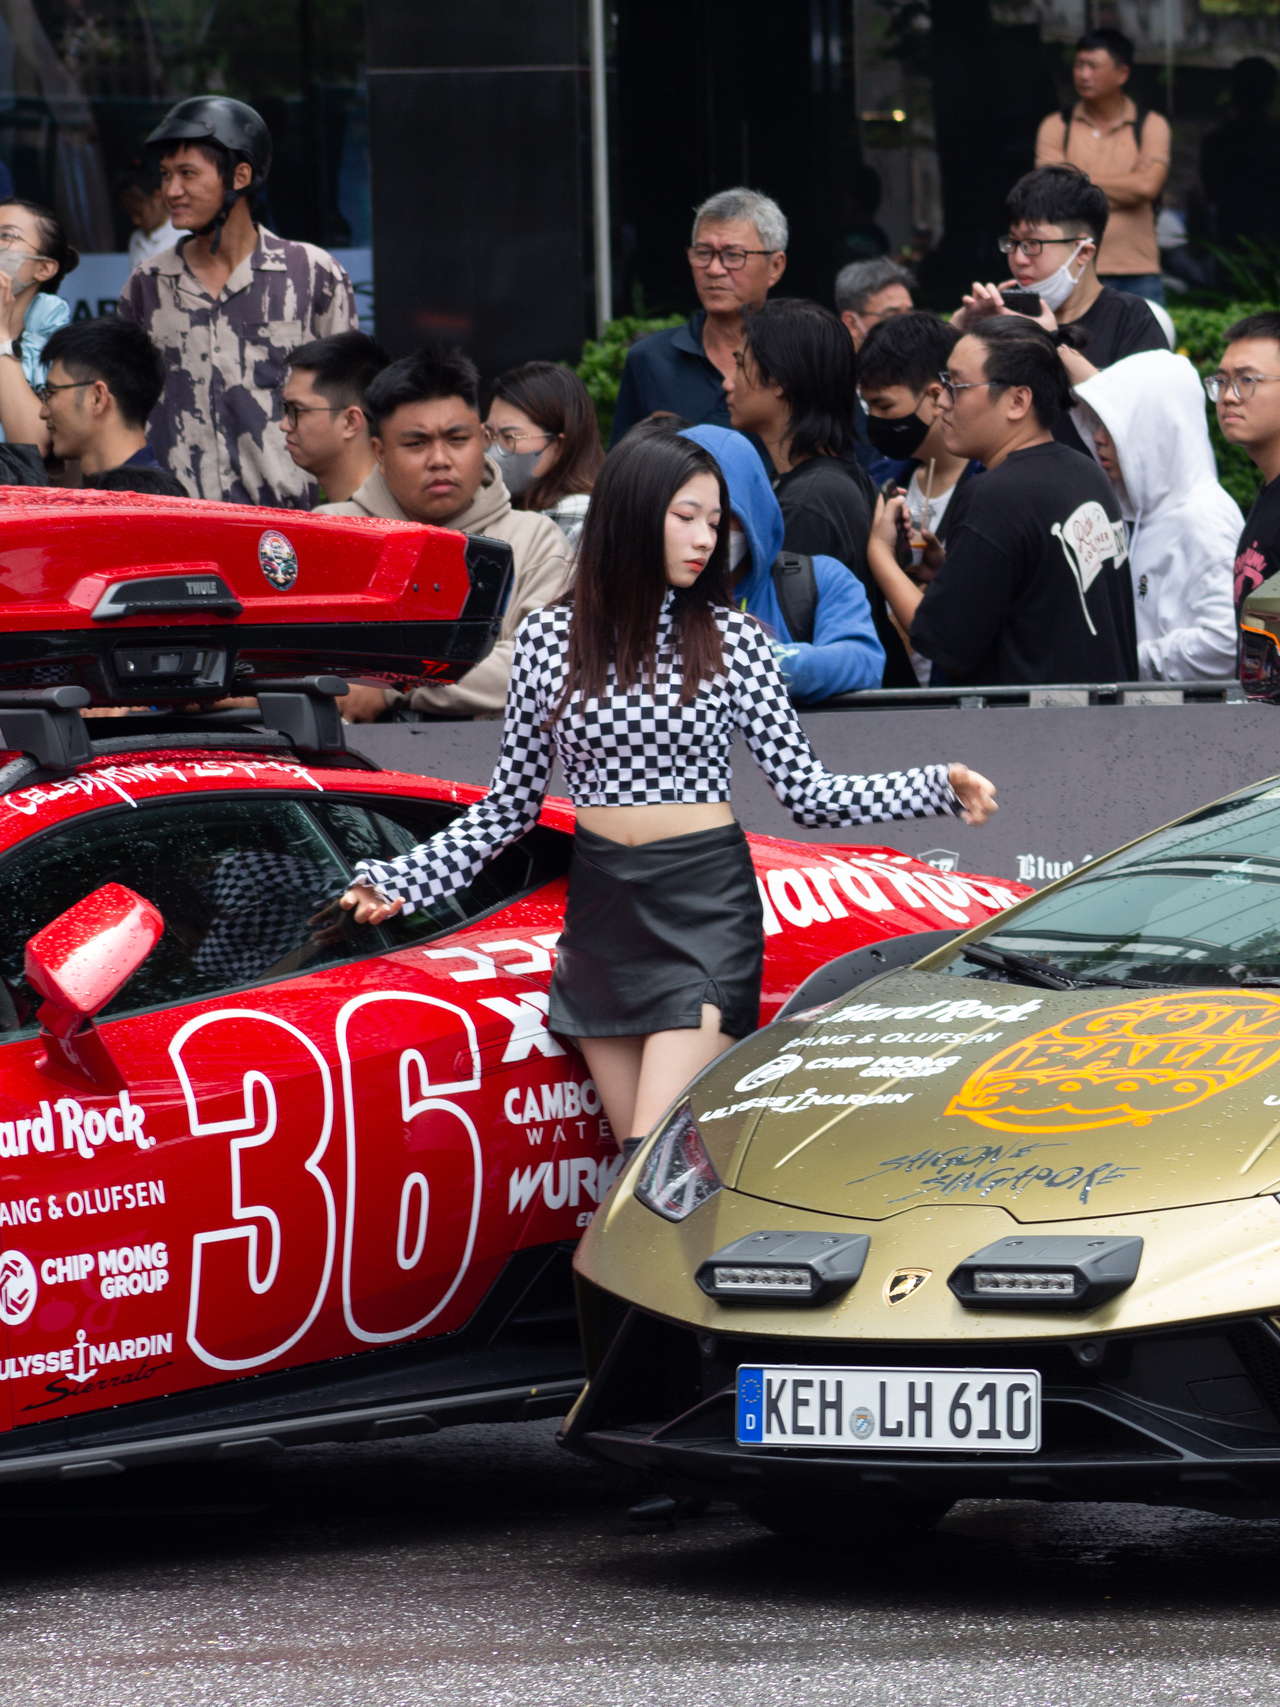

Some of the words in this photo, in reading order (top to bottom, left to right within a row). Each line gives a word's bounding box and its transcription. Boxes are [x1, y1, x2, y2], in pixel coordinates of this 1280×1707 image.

[186, 581, 218, 595] THULE
[1016, 853, 1075, 881] Blue
[757, 855, 896, 936] ard
[817, 1001, 943, 1024] Hard
[926, 999, 1044, 1023] Rock
[779, 1034, 856, 1051] BANG
[857, 1033, 877, 1043] &
[881, 1032, 1003, 1045] OLUFSEN
[804, 1056, 874, 1070] CHIP
[868, 1056, 962, 1068] MONG
[858, 1066, 948, 1078] GROUP
[504, 1079, 606, 1125] CAMBO
[699, 1096, 795, 1122] ULYSSE
[802, 1093, 914, 1106] NARDIN
[0, 1101, 55, 1159] ard
[54, 1090, 151, 1159] Rock
[526, 1119, 611, 1146] WATE
[168, 991, 483, 1371] 36
[887, 1163, 1141, 1205] SINGAPORE
[0, 1198, 42, 1227] ANG
[48, 1195, 63, 1220] &
[66, 1180, 166, 1217] OLUFSEN
[41, 1253, 95, 1285] CHIP
[98, 1242, 168, 1276] MONG
[100, 1269, 169, 1300] GROUP
[89, 1332, 173, 1366] NARDIN
[30, 1359, 165, 1405] Sterrato
[745, 1413, 756, 1430] D
[765, 1378, 843, 1436] KEH
[879, 1381, 933, 1438] LH
[949, 1382, 1032, 1439] 610
